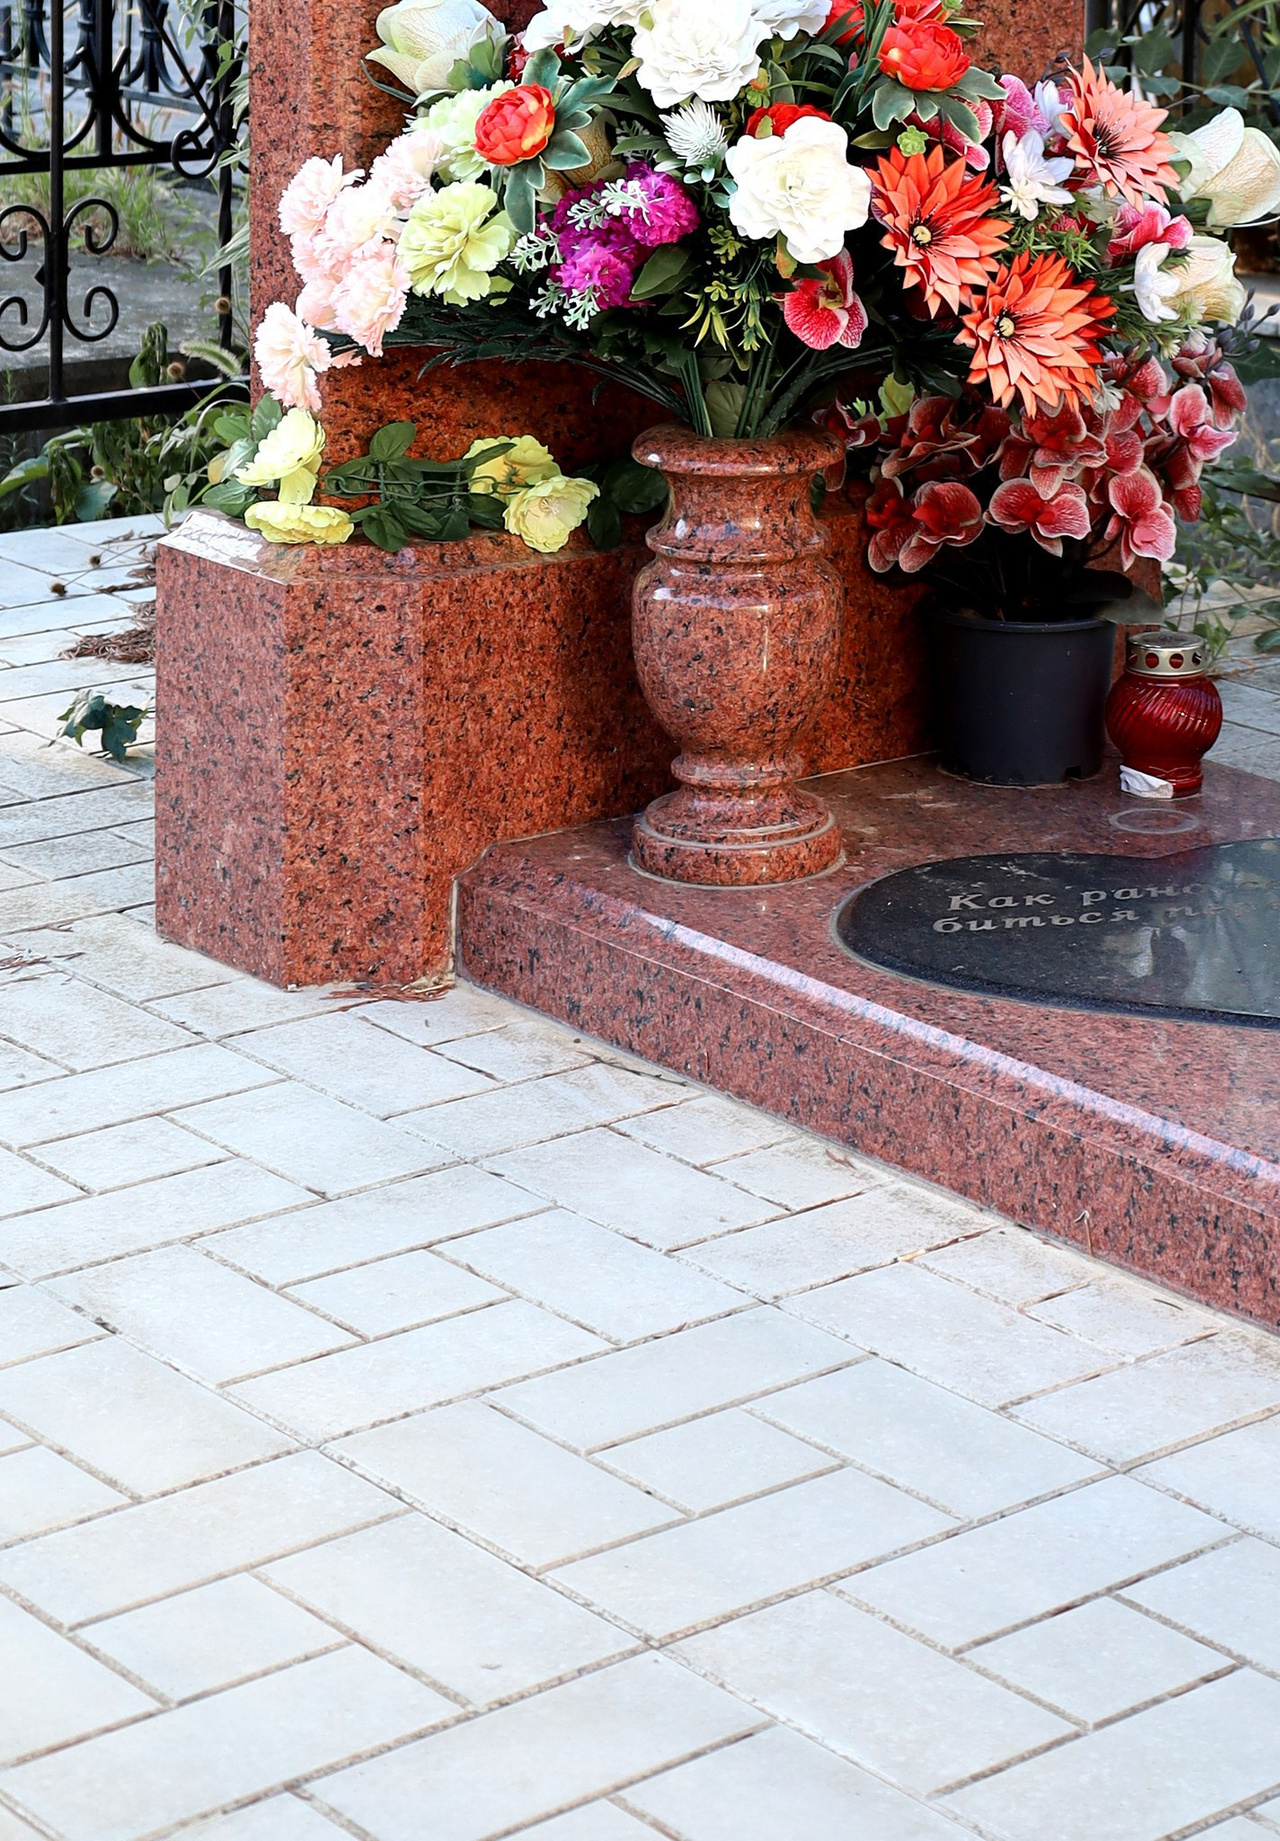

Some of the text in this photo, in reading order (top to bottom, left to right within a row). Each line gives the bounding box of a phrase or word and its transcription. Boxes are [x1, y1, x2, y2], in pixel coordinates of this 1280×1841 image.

[949, 892, 1056, 911] Как
[1080, 881, 1208, 907] рано
[931, 908, 1141, 935] биться
